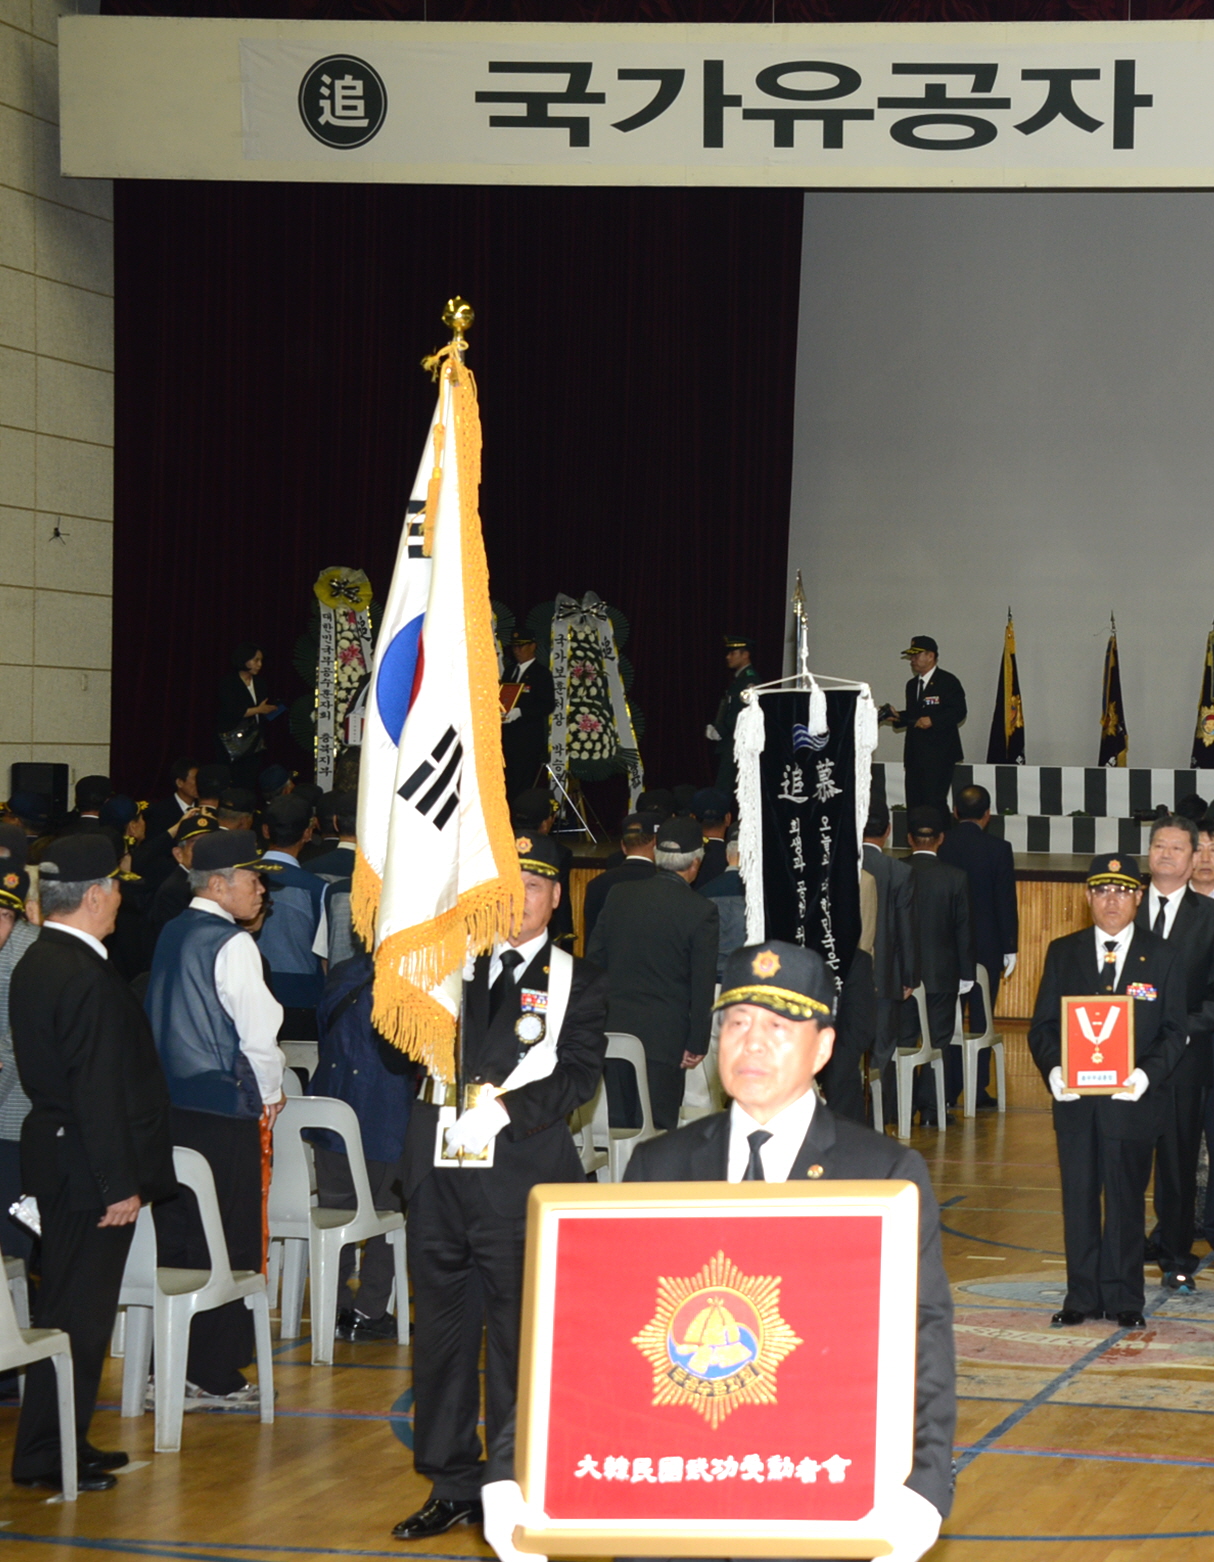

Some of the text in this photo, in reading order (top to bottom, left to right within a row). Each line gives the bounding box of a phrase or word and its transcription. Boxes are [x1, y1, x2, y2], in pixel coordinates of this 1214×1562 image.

[318, 74, 369, 127] 追
[475, 59, 1153, 150] 국가유공자
[777, 757, 843, 804] 追慕
